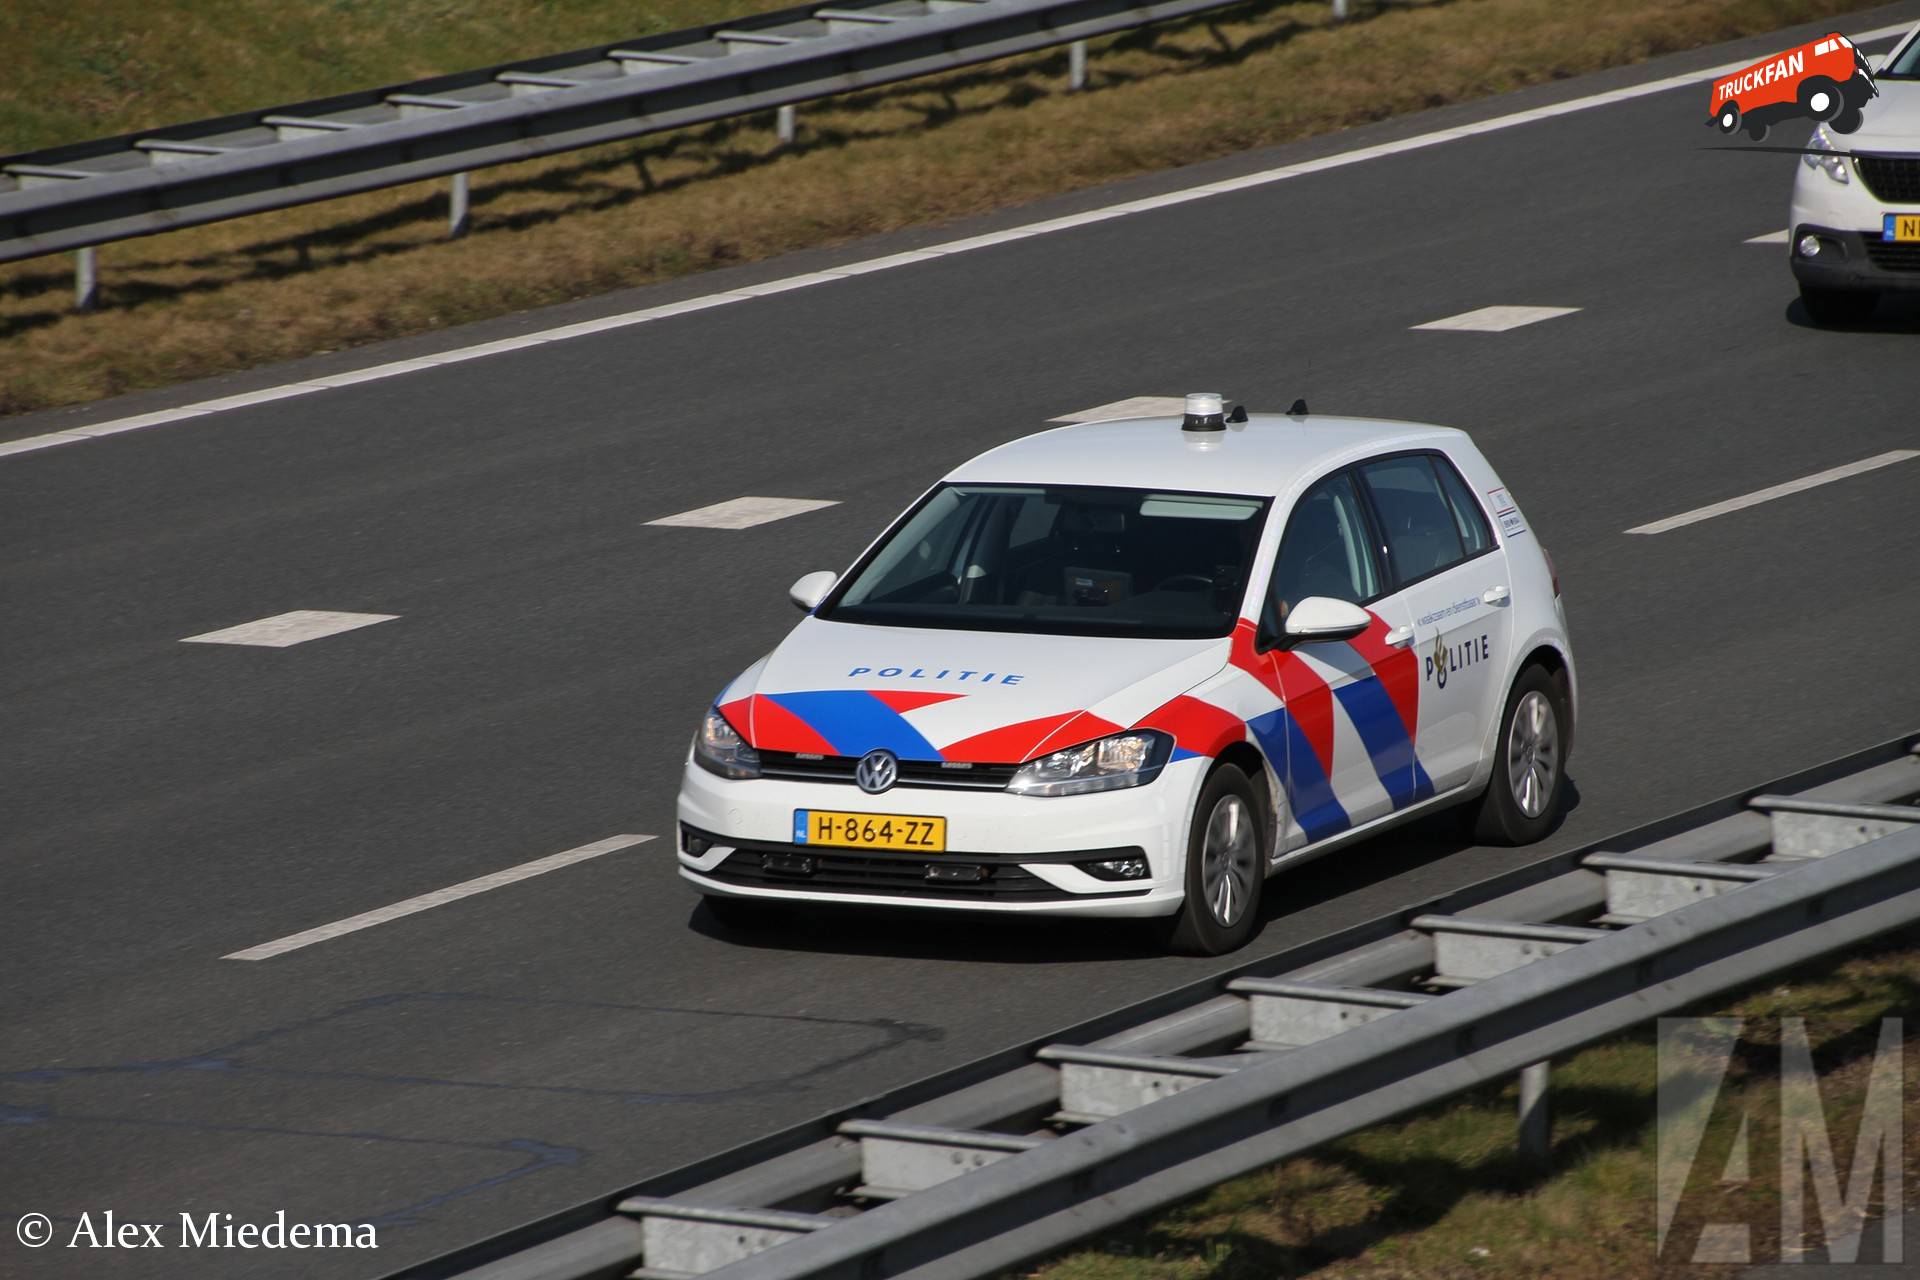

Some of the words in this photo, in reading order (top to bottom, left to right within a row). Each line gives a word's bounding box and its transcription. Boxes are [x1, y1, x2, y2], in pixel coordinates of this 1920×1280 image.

[1904, 219, 1920, 237] N
[1425, 634, 1489, 689] POLITIE
[848, 666, 1025, 686] POLITIE
[817, 816, 935, 846] H-864-ZZ
